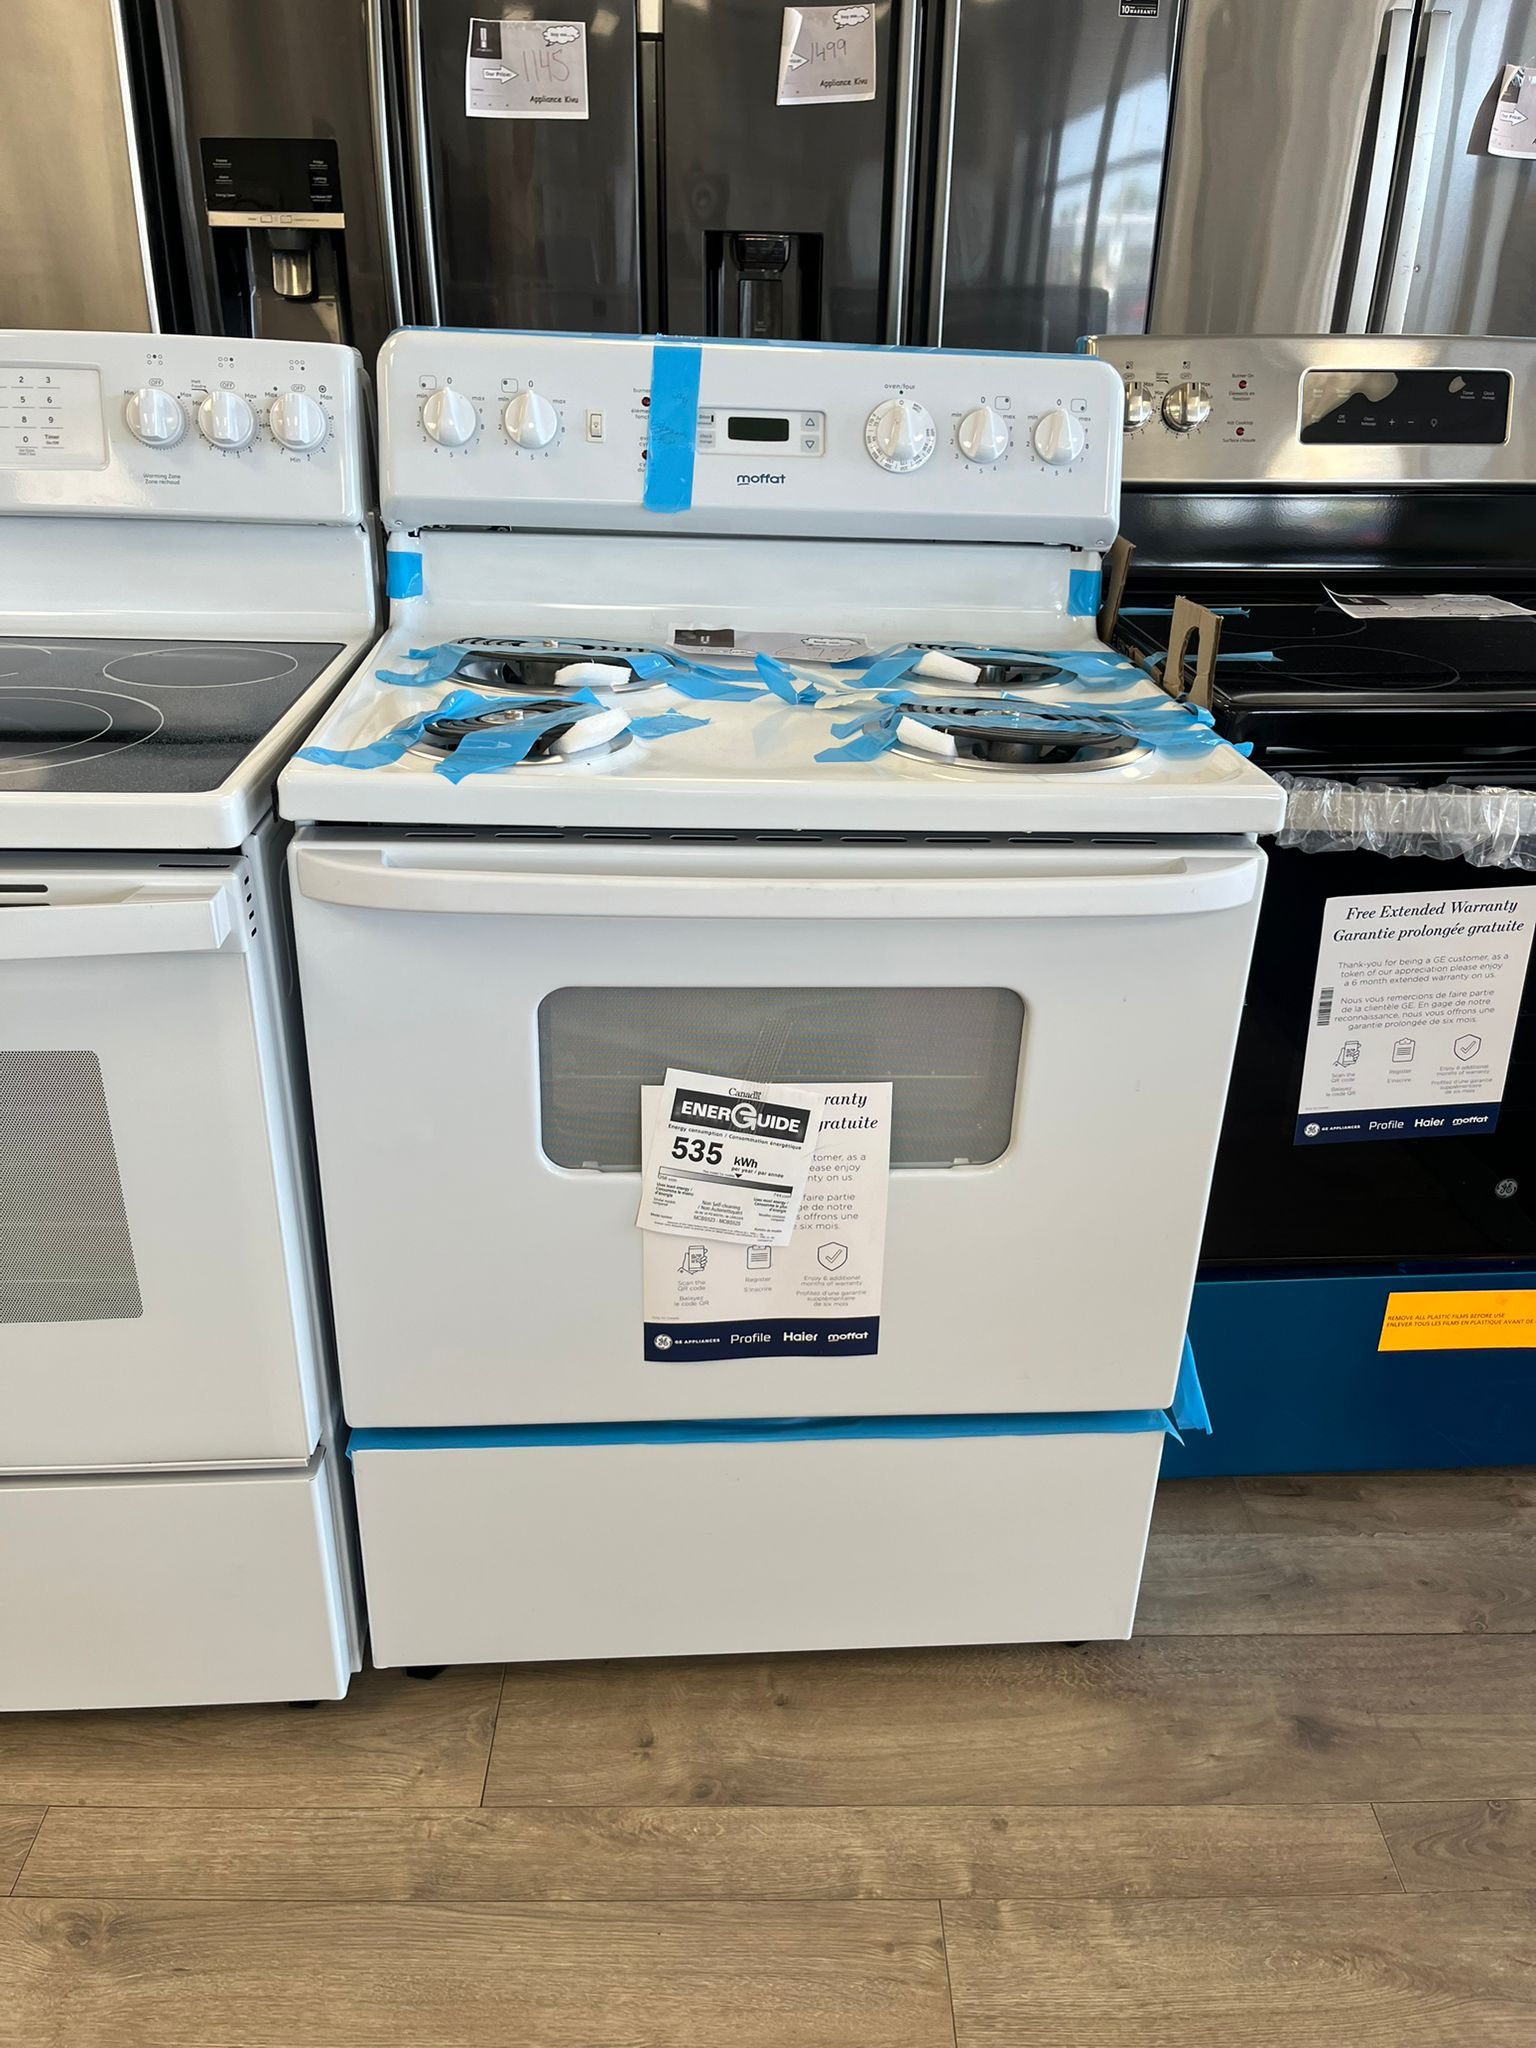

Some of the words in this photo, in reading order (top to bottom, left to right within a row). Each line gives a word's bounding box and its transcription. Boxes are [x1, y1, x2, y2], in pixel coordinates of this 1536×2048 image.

[810, 38, 847, 64] 1499
[522, 48, 570, 82] 1145
[820, 79, 851, 88] Appliance
[530, 96, 562, 105] Appliance
[737, 474, 786, 486] moffat
[1345, 907, 1376, 920] Free
[1380, 902, 1446, 919] Extended
[1450, 900, 1518, 914] Warranty
[1334, 928, 1395, 942] Garantie
[1398, 922, 1465, 941] prolongée
[1467, 920, 1524, 936] gratuite
[1338, 961, 1382, 970] Thank-you
[1385, 959, 1396, 967] for
[1399, 958, 1422, 967] being
[1341, 970, 1364, 978] token
[1394, 965, 1447, 975] appreciation
[1450, 963, 1477, 972] please
[1480, 962, 1503, 971] enjoy
[1390, 975, 1429, 984] extended
[1432, 973, 1469, 982] warranty
[1387, 993, 1433, 1001] remercions
[1470, 990, 1495, 998] partie
[1364, 1003, 1399, 1012] clientèle
[1432, 1001, 1452, 1009] gage
[1348, 1022, 1382, 1031] garantie
[1385, 1019, 1427, 1028] prolongée
[681, 1100, 800, 1133] ENERGUIDE
[1369, 1120, 1404, 1130] Profile
[1414, 1118, 1445, 1128] Haier
[1452, 1116, 1488, 1126] moffat
[668, 1123, 687, 1133] Energy
[688, 1126, 723, 1138] consumption
[728, 1134, 768, 1145] Consommation
[770, 1139, 802, 1150] énergétique
[672, 1136, 724, 1165] 535
[734, 1156, 758, 1169] kWh
[827, 1194, 856, 1202] partie
[730, 1333, 771, 1344] Profile
[783, 1331, 818, 1342] Haier
[828, 1331, 869, 1342] moffat
